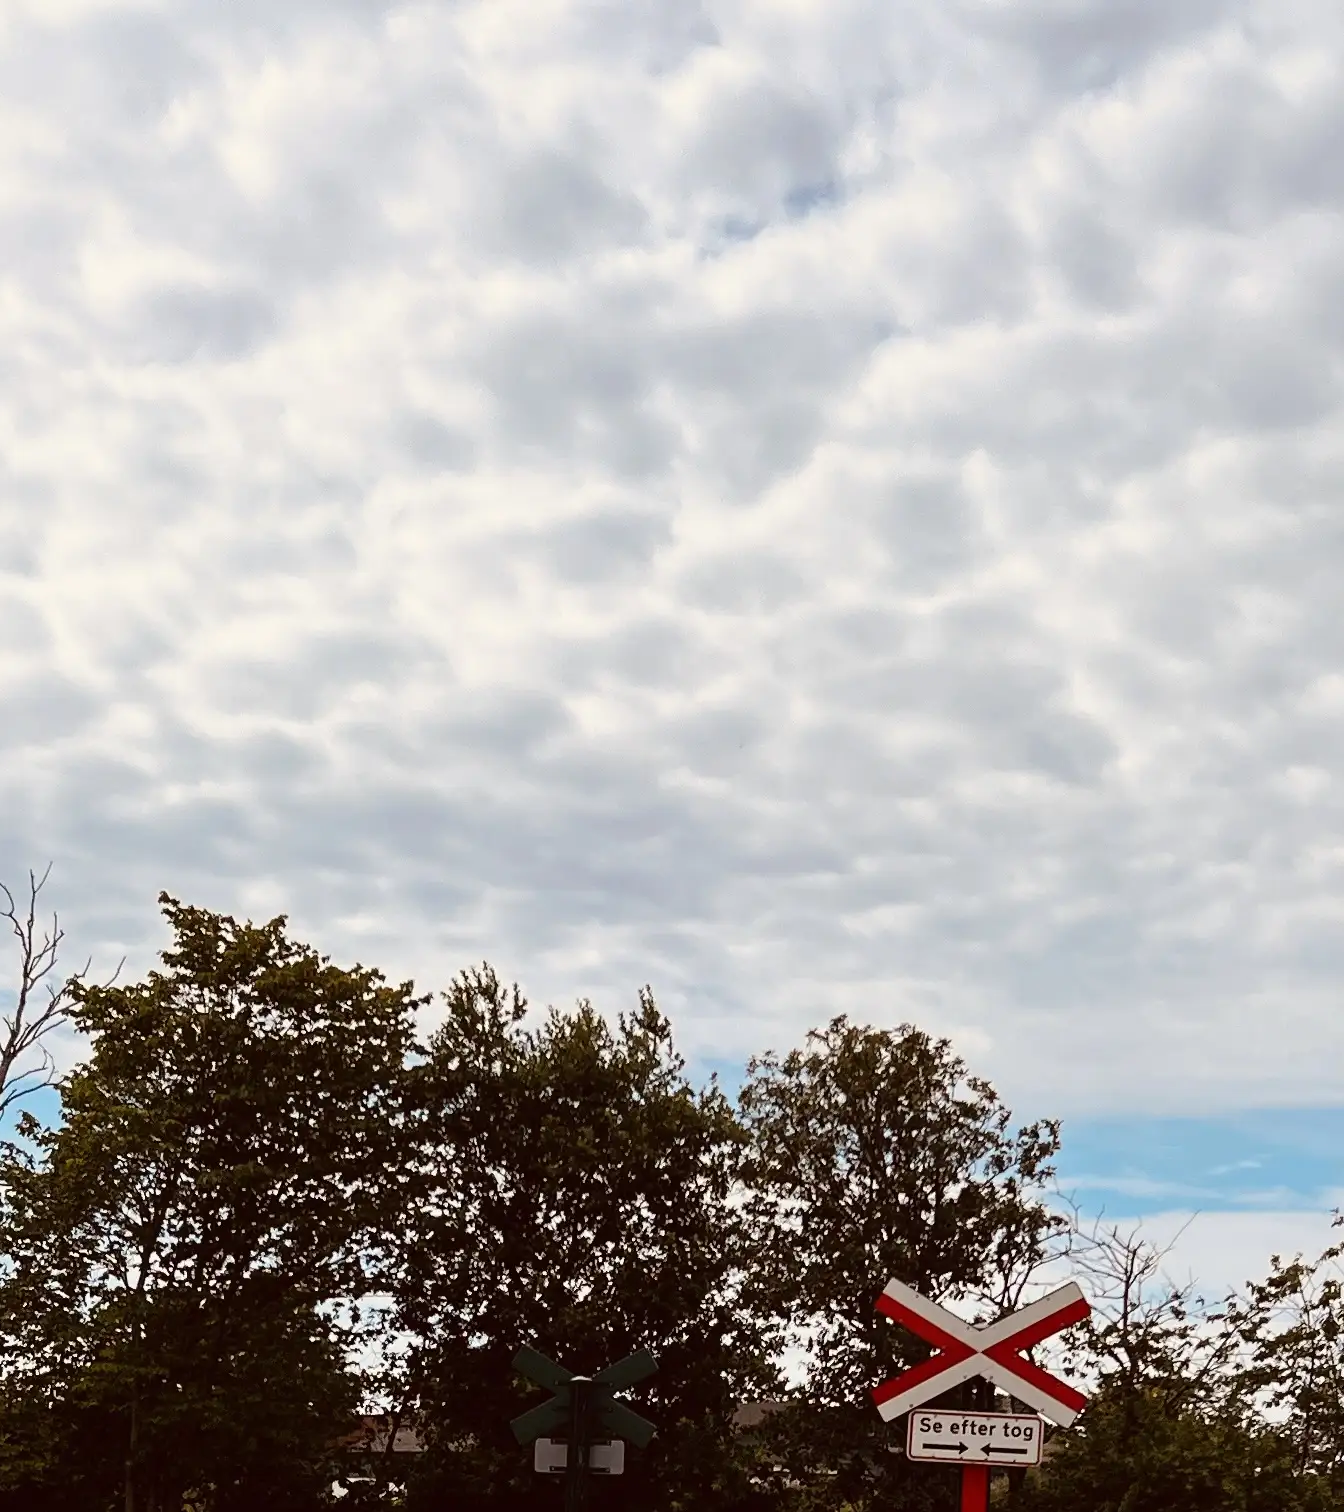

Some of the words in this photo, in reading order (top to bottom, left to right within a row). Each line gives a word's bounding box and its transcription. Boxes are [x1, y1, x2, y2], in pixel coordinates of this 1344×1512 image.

[920, 1417, 943, 1434] Se
[950, 1419, 996, 1436] efter
[1003, 1422, 1033, 1441] tog
